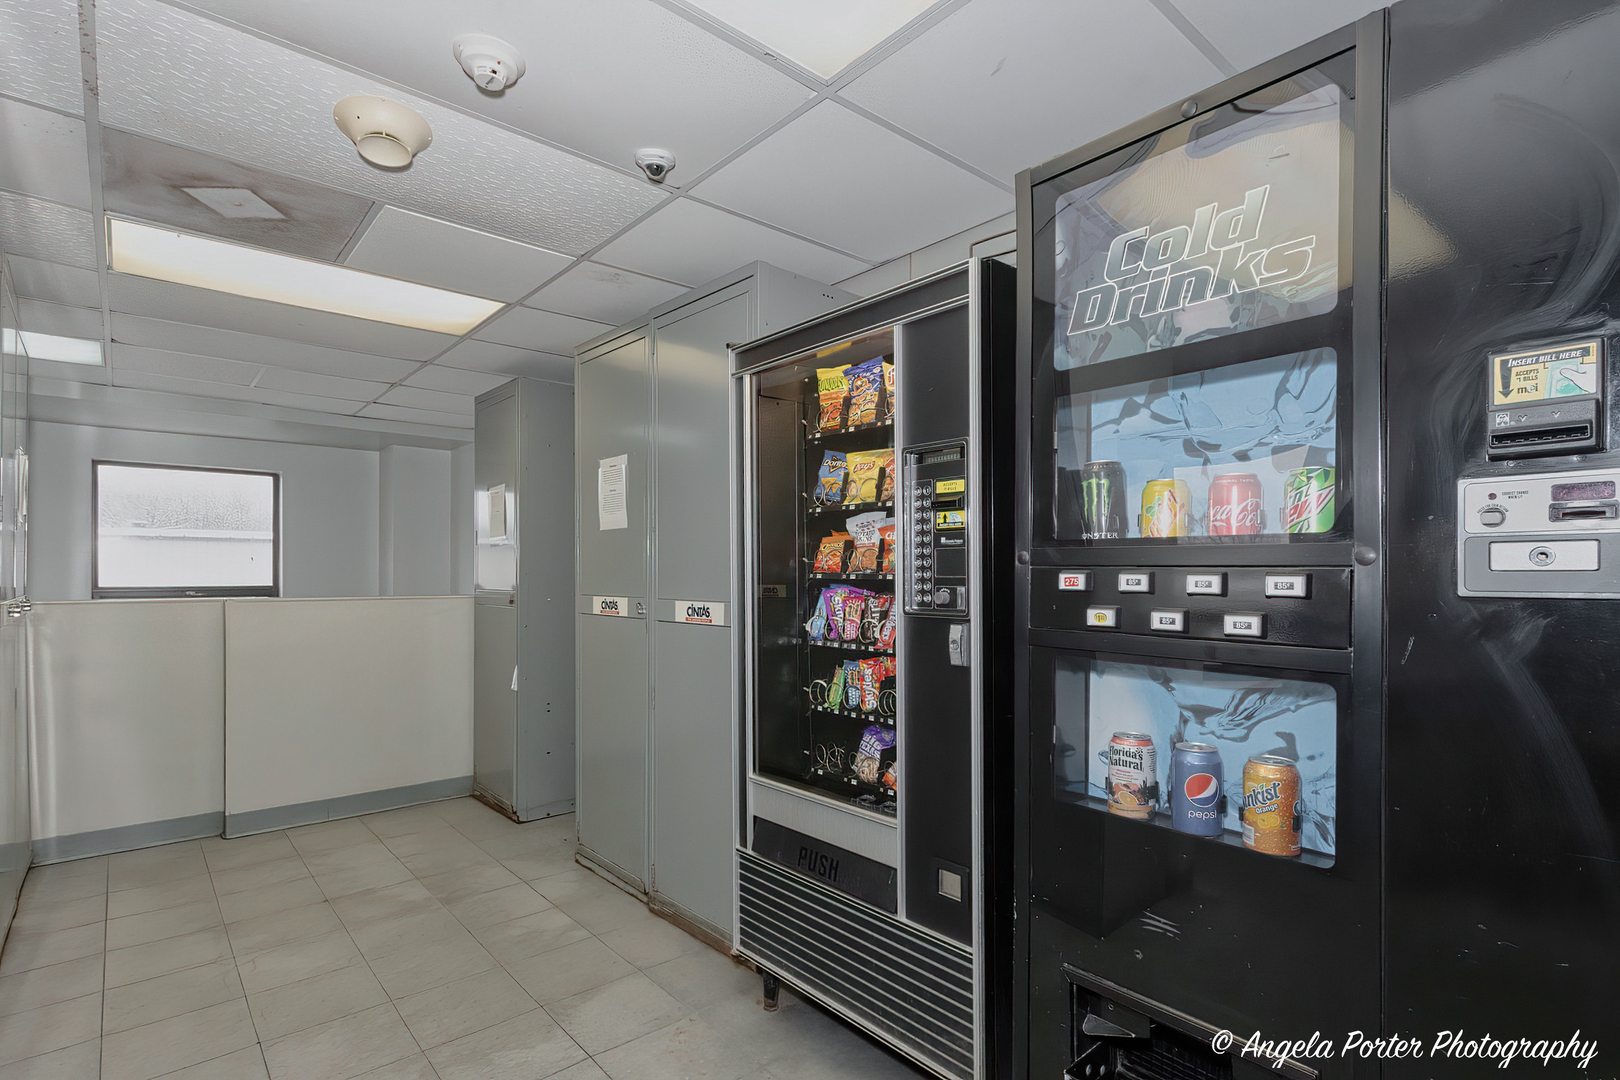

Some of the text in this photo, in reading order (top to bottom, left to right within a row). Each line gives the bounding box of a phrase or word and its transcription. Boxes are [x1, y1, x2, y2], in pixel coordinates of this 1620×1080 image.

[1104, 184, 1270, 283] Cold
[1507, 356, 1539, 368] INSERT
[1538, 353, 1557, 363] BILL
[1559, 349, 1583, 360] HERE
[1515, 368, 1539, 377] ACCEPTS
[1081, 532, 1119, 540] ONSTER
[1064, 577, 1079, 586] 275
[1109, 755, 1144, 773] Natural
[1243, 780, 1282, 810] unkist
[1188, 809, 1218, 821] pepsi
[797, 845, 840, 882] PUSH
